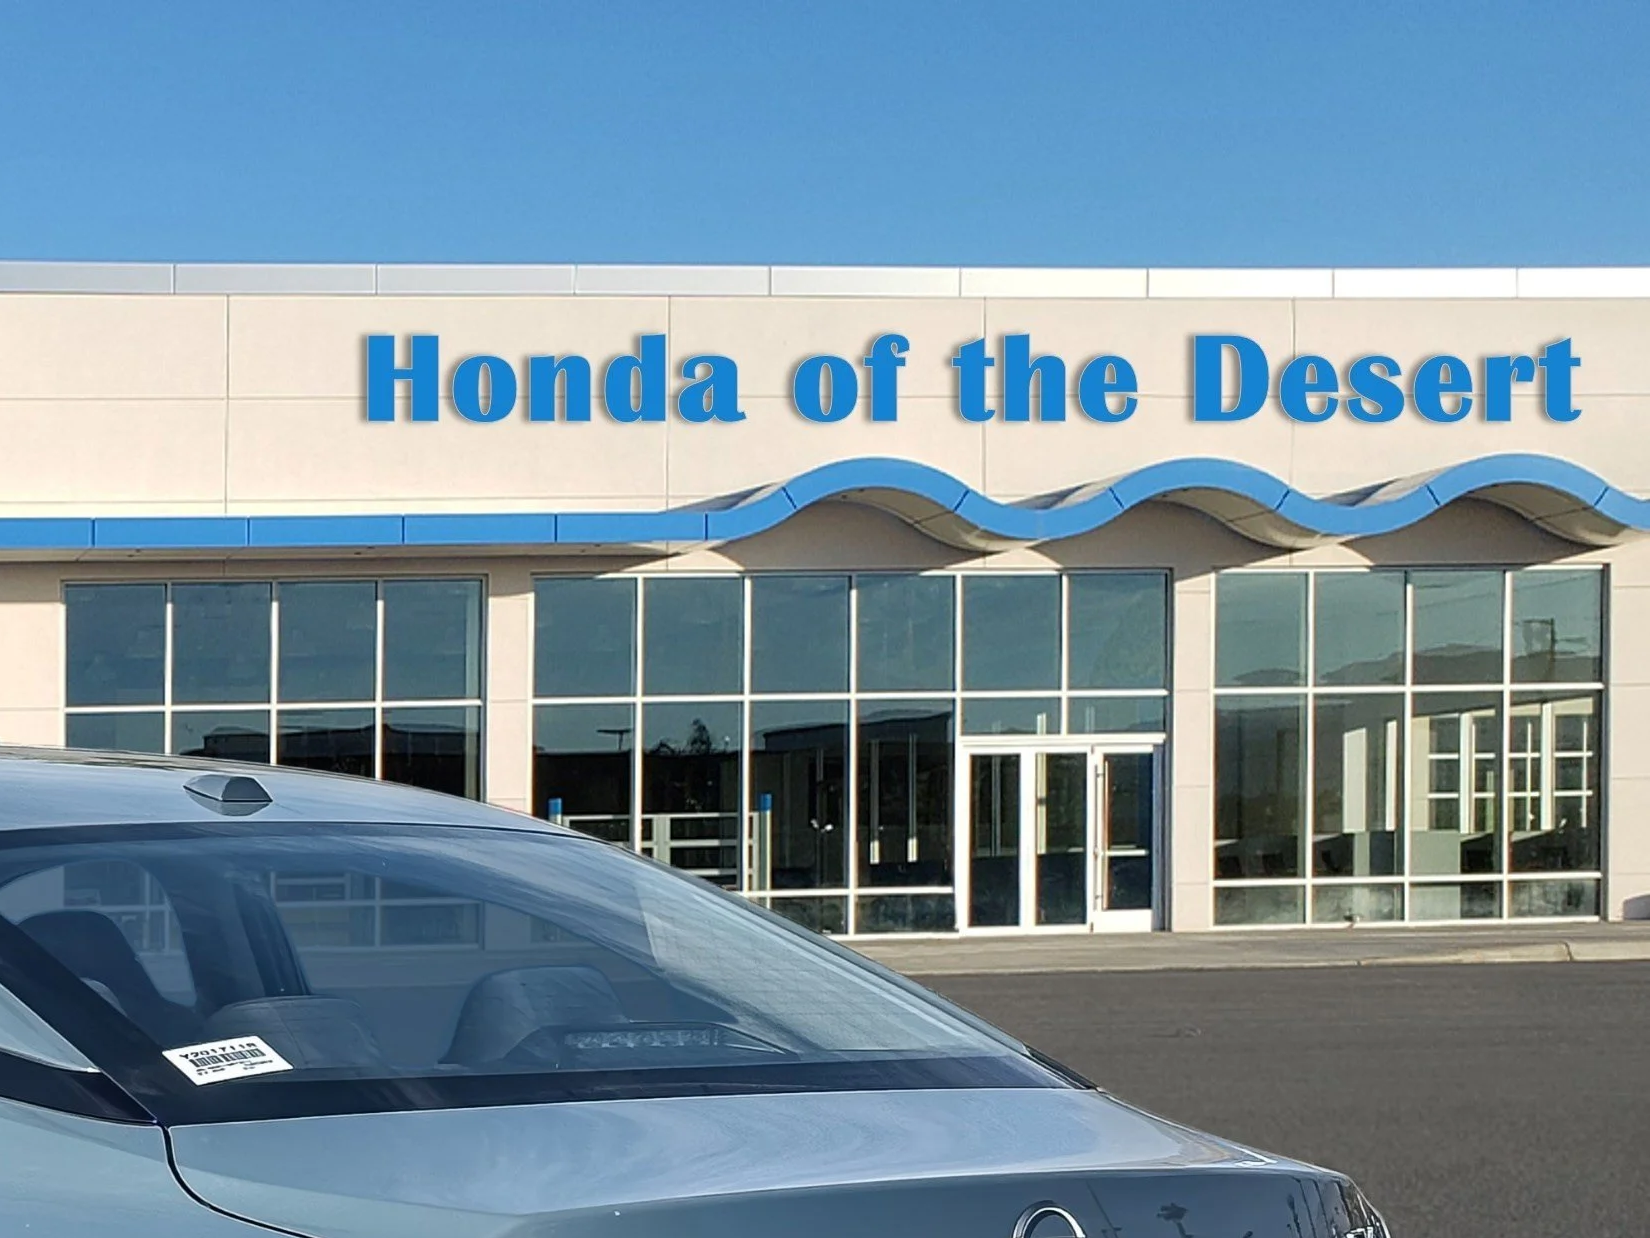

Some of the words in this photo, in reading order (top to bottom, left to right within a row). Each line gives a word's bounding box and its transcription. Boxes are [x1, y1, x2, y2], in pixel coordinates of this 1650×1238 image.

[364, 333, 747, 424] Honda
[793, 332, 911, 424] of
[951, 333, 1139, 424] the
[1192, 333, 1582, 424] Desert
